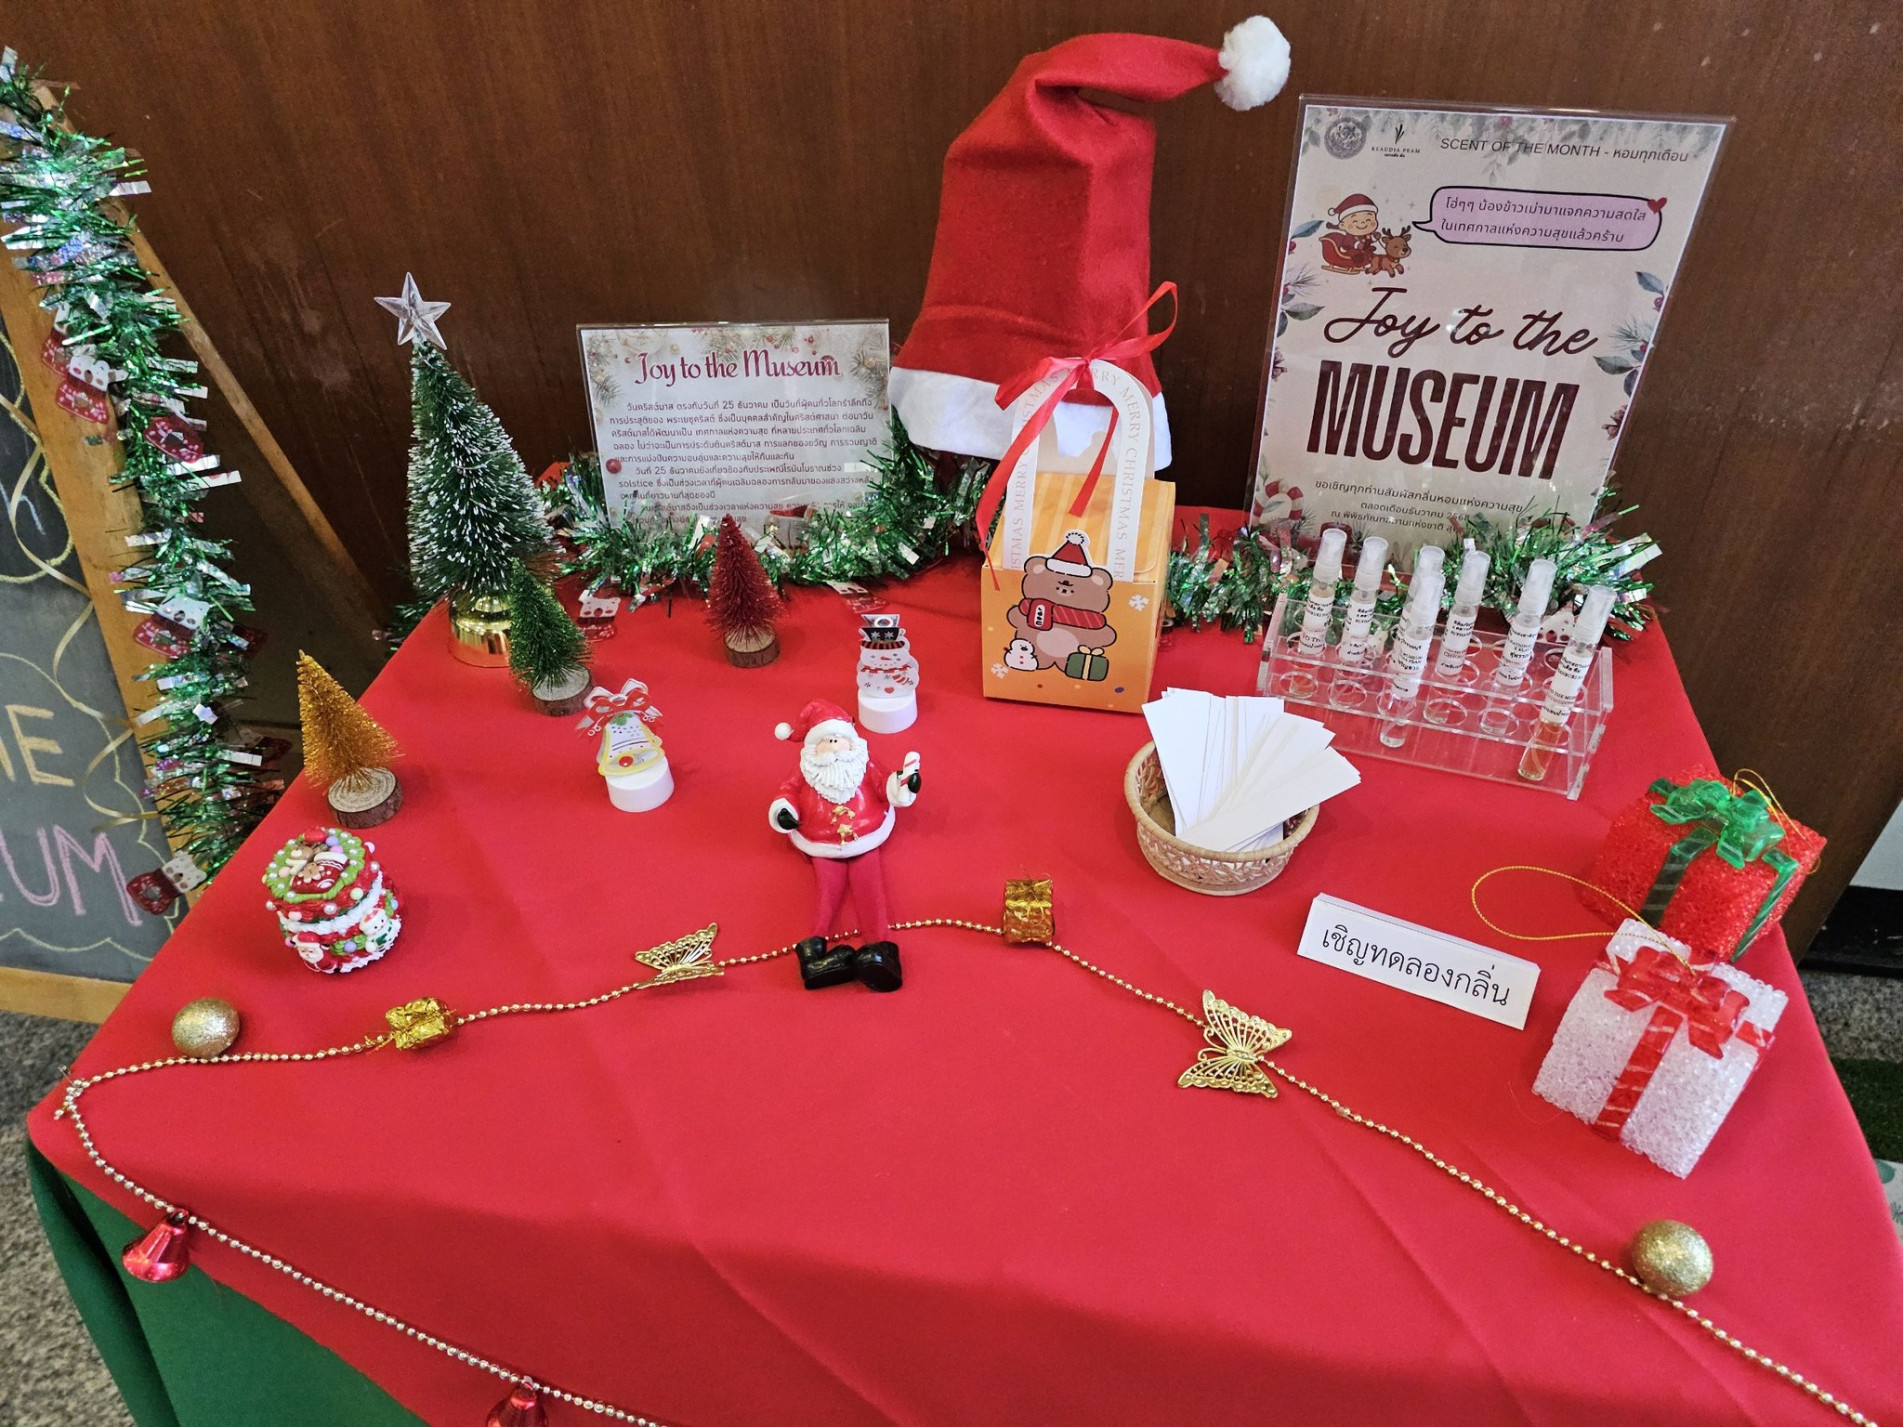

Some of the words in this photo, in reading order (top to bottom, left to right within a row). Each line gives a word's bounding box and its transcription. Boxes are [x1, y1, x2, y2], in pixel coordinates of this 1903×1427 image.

[1440, 137, 1488, 151] SCENT
[1491, 140, 1512, 152] OF
[1516, 142, 1544, 154] THE
[1547, 143, 1601, 157] MONTH
[1323, 286, 1441, 359] Joy
[1450, 304, 1504, 346] to
[1512, 310, 1599, 357] the
[634, 351, 677, 387] Joy
[680, 356, 701, 379] to
[704, 350, 739, 378] the
[743, 348, 841, 378] Museum
[722, 400, 734, 410] 25
[1119, 385, 1141, 442] MERRY
[1306, 359, 1580, 481] MUSEUM
[618, 479, 654, 488] solstice
[654, 466, 667, 475] 25
[1012, 462, 1029, 517] MERRY
[1115, 447, 1139, 541] CHRISTMAS
[0, 704, 75, 787] E
[0, 823, 143, 928] UM
[1322, 922, 1511, 1007] เชิญทดลองกลิ่น
